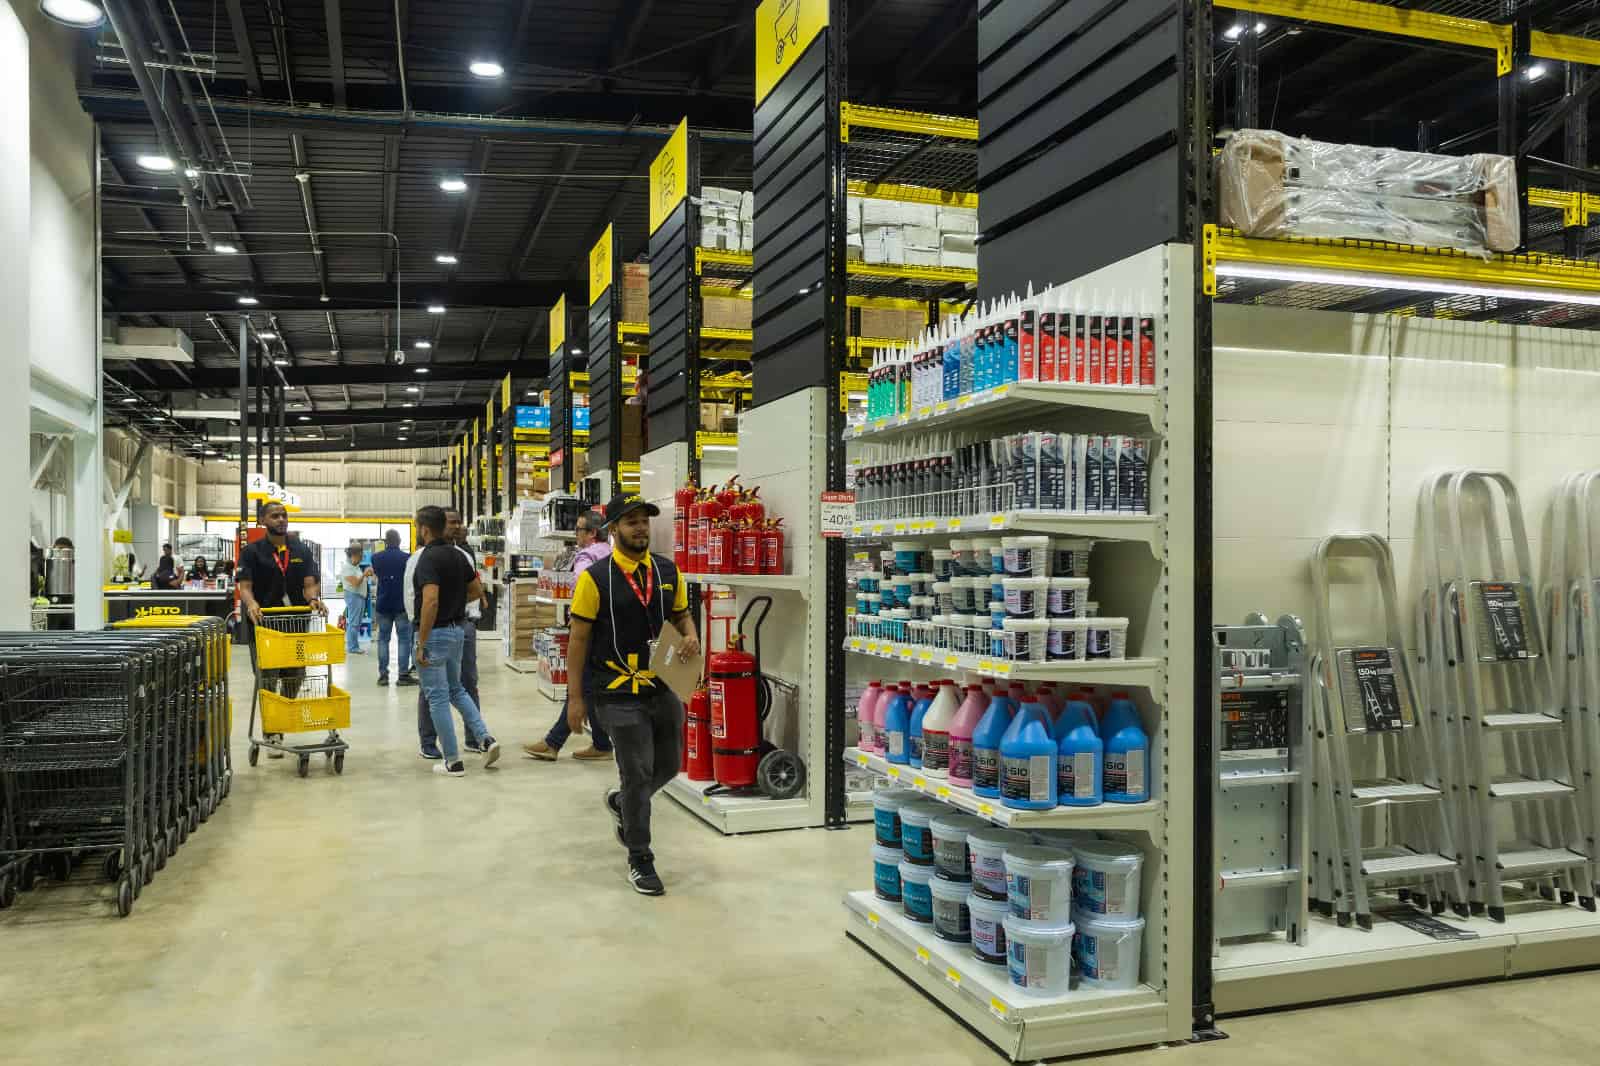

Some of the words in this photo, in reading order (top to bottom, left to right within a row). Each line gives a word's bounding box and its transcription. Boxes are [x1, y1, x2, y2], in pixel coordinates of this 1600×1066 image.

[253, 477, 261, 488] 4
[267, 485, 275, 495] 3
[280, 492, 287, 502] 2
